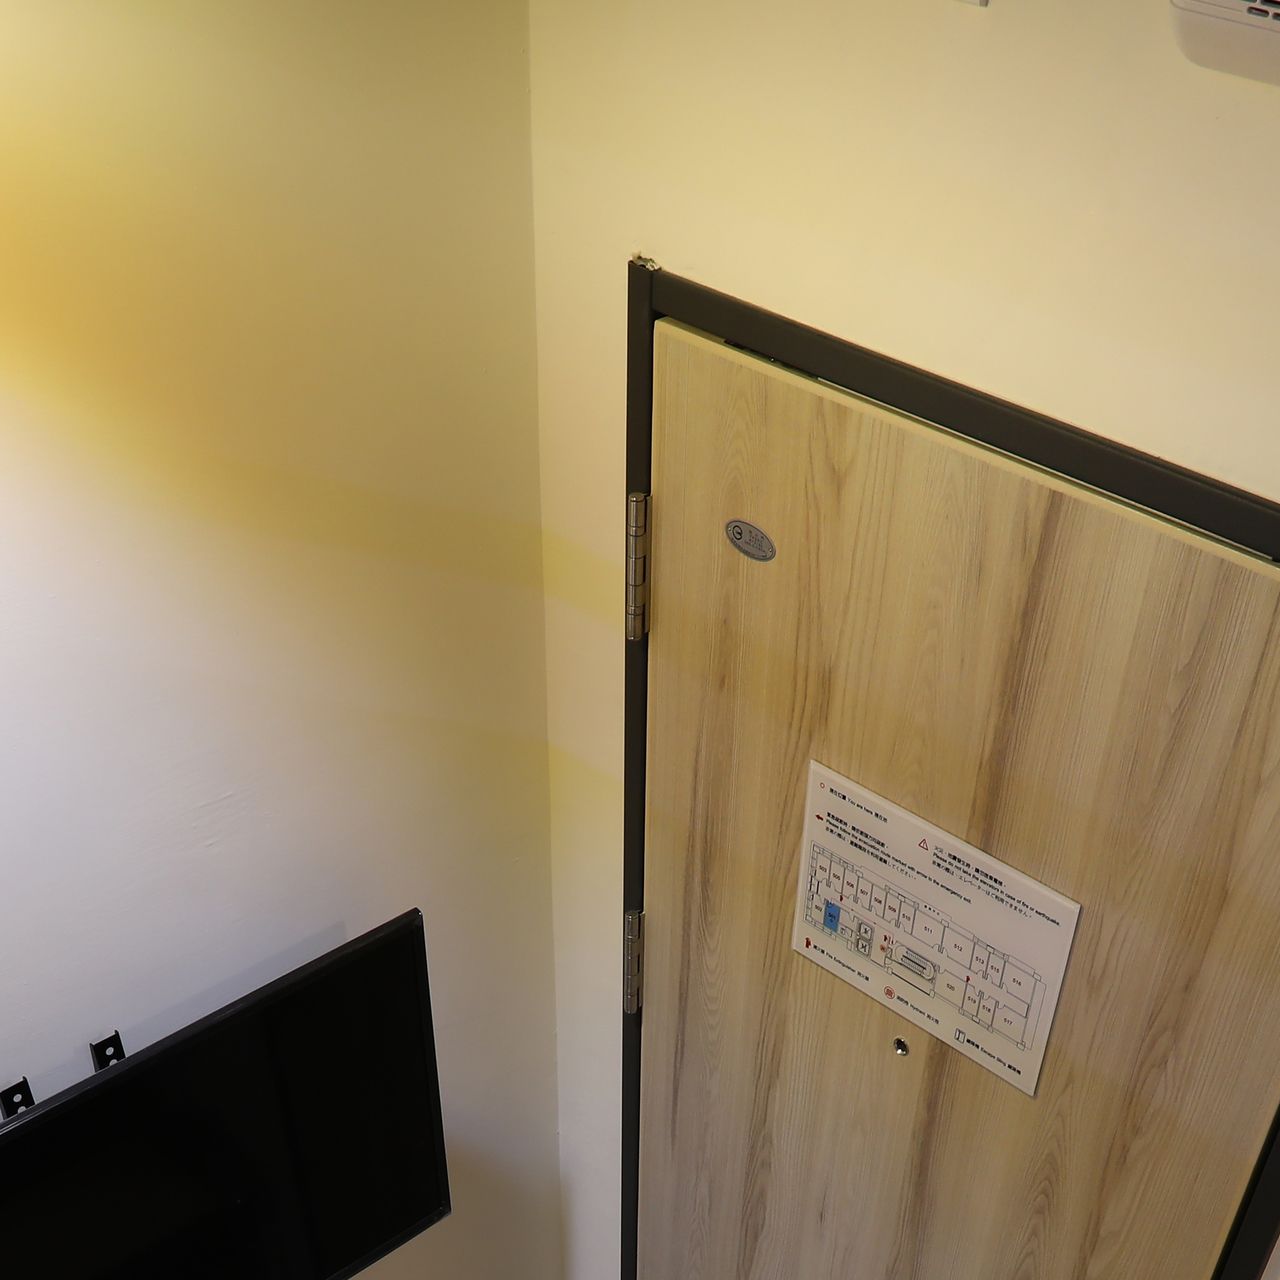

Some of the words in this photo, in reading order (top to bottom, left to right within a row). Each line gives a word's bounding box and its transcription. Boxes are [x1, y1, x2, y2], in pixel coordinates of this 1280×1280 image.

[847, 797, 855, 806] You
[863, 806, 873, 815] here
[825, 818, 839, 829] Please
[839, 826, 850, 836] follow
[858, 836, 879, 852] evacuation
[880, 849, 891, 858] route
[891, 855, 907, 868] marked
[907, 864, 916, 873] with
[916, 870, 927, 879] arrow
[932, 878, 940, 886] the
[939, 883, 962, 900] emergency
[818, 864, 827, 873] 503
[831, 871, 841, 881] 505
[932, 851, 947, 863] Please
[947, 859, 954, 867] do
[953, 863, 961, 871] not
[961, 868, 971, 877] take
[971, 873, 979, 881] the
[979, 877, 999, 893] elevators
[1004, 892, 1016, 902] case
[1016, 897, 1021, 905] of
[1021, 900, 1029, 909] fire
[845, 879, 854, 889] 506
[859, 887, 868, 897] 507
[873, 895, 882, 905] 508
[887, 904, 896, 913] 509
[901, 912, 911, 922] 510
[923, 925, 932, 934] 511
[953, 943, 962, 952] 512
[825, 951, 833, 959] Fire
[833, 955, 856, 974] Extinguisher
[974, 955, 984, 965] 513
[990, 964, 1000, 974] 515
[1011, 976, 1022, 987] 516
[945, 982, 955, 992] 520
[966, 995, 976, 1005] 519
[909, 1003, 925, 1017] Hydrant
[981, 1004, 991, 1013] 518
[1003, 1016, 1013, 1026] 517
[980, 1046, 996, 1060] Escape
[995, 1056, 1006, 1067] Sling
